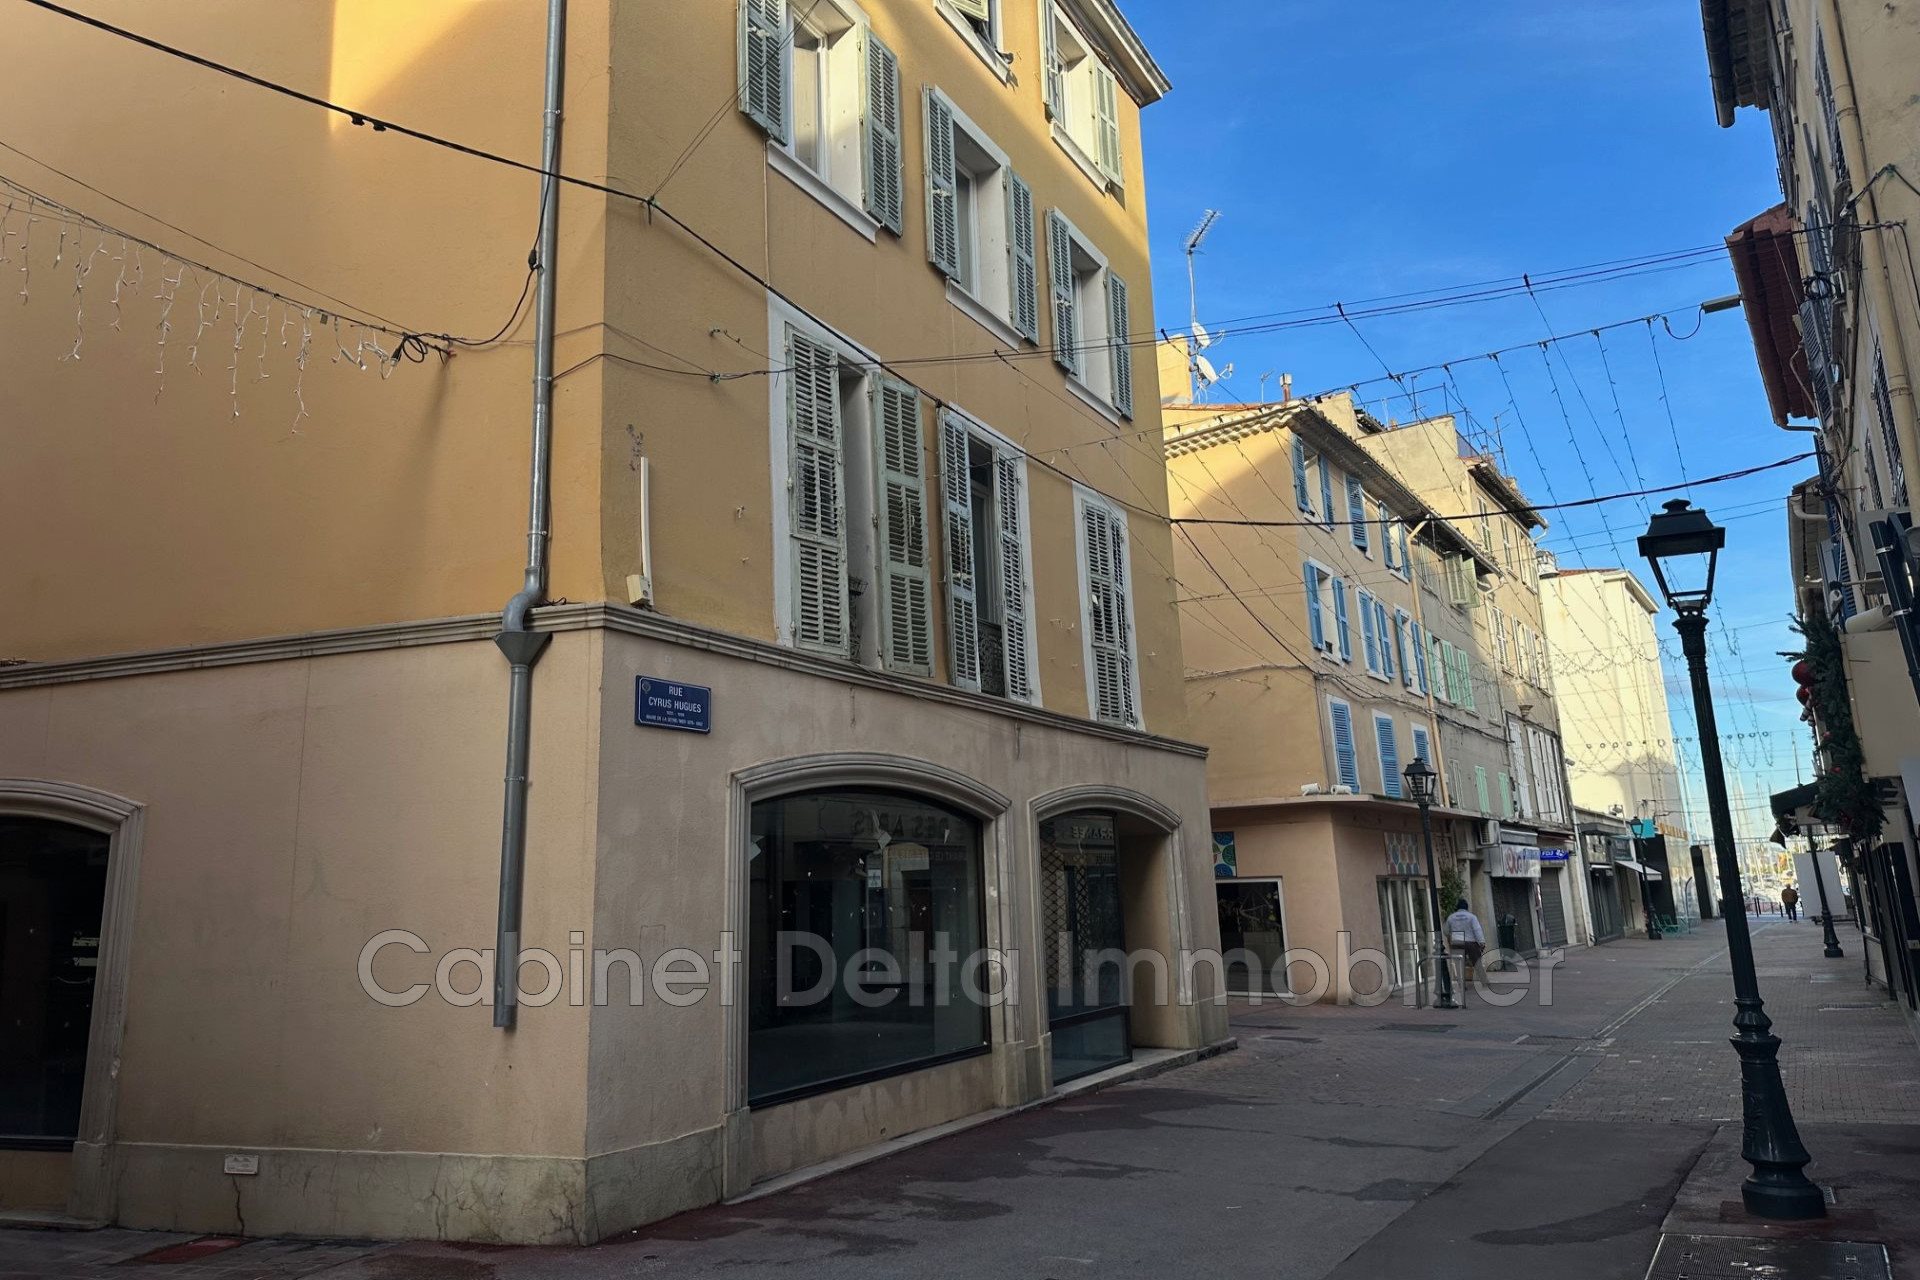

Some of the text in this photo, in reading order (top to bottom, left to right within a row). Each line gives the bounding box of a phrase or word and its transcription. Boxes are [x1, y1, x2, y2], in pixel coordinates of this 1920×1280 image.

[669, 686, 683, 696] RUE
[648, 696, 702, 713] CYRUS HUGUES
